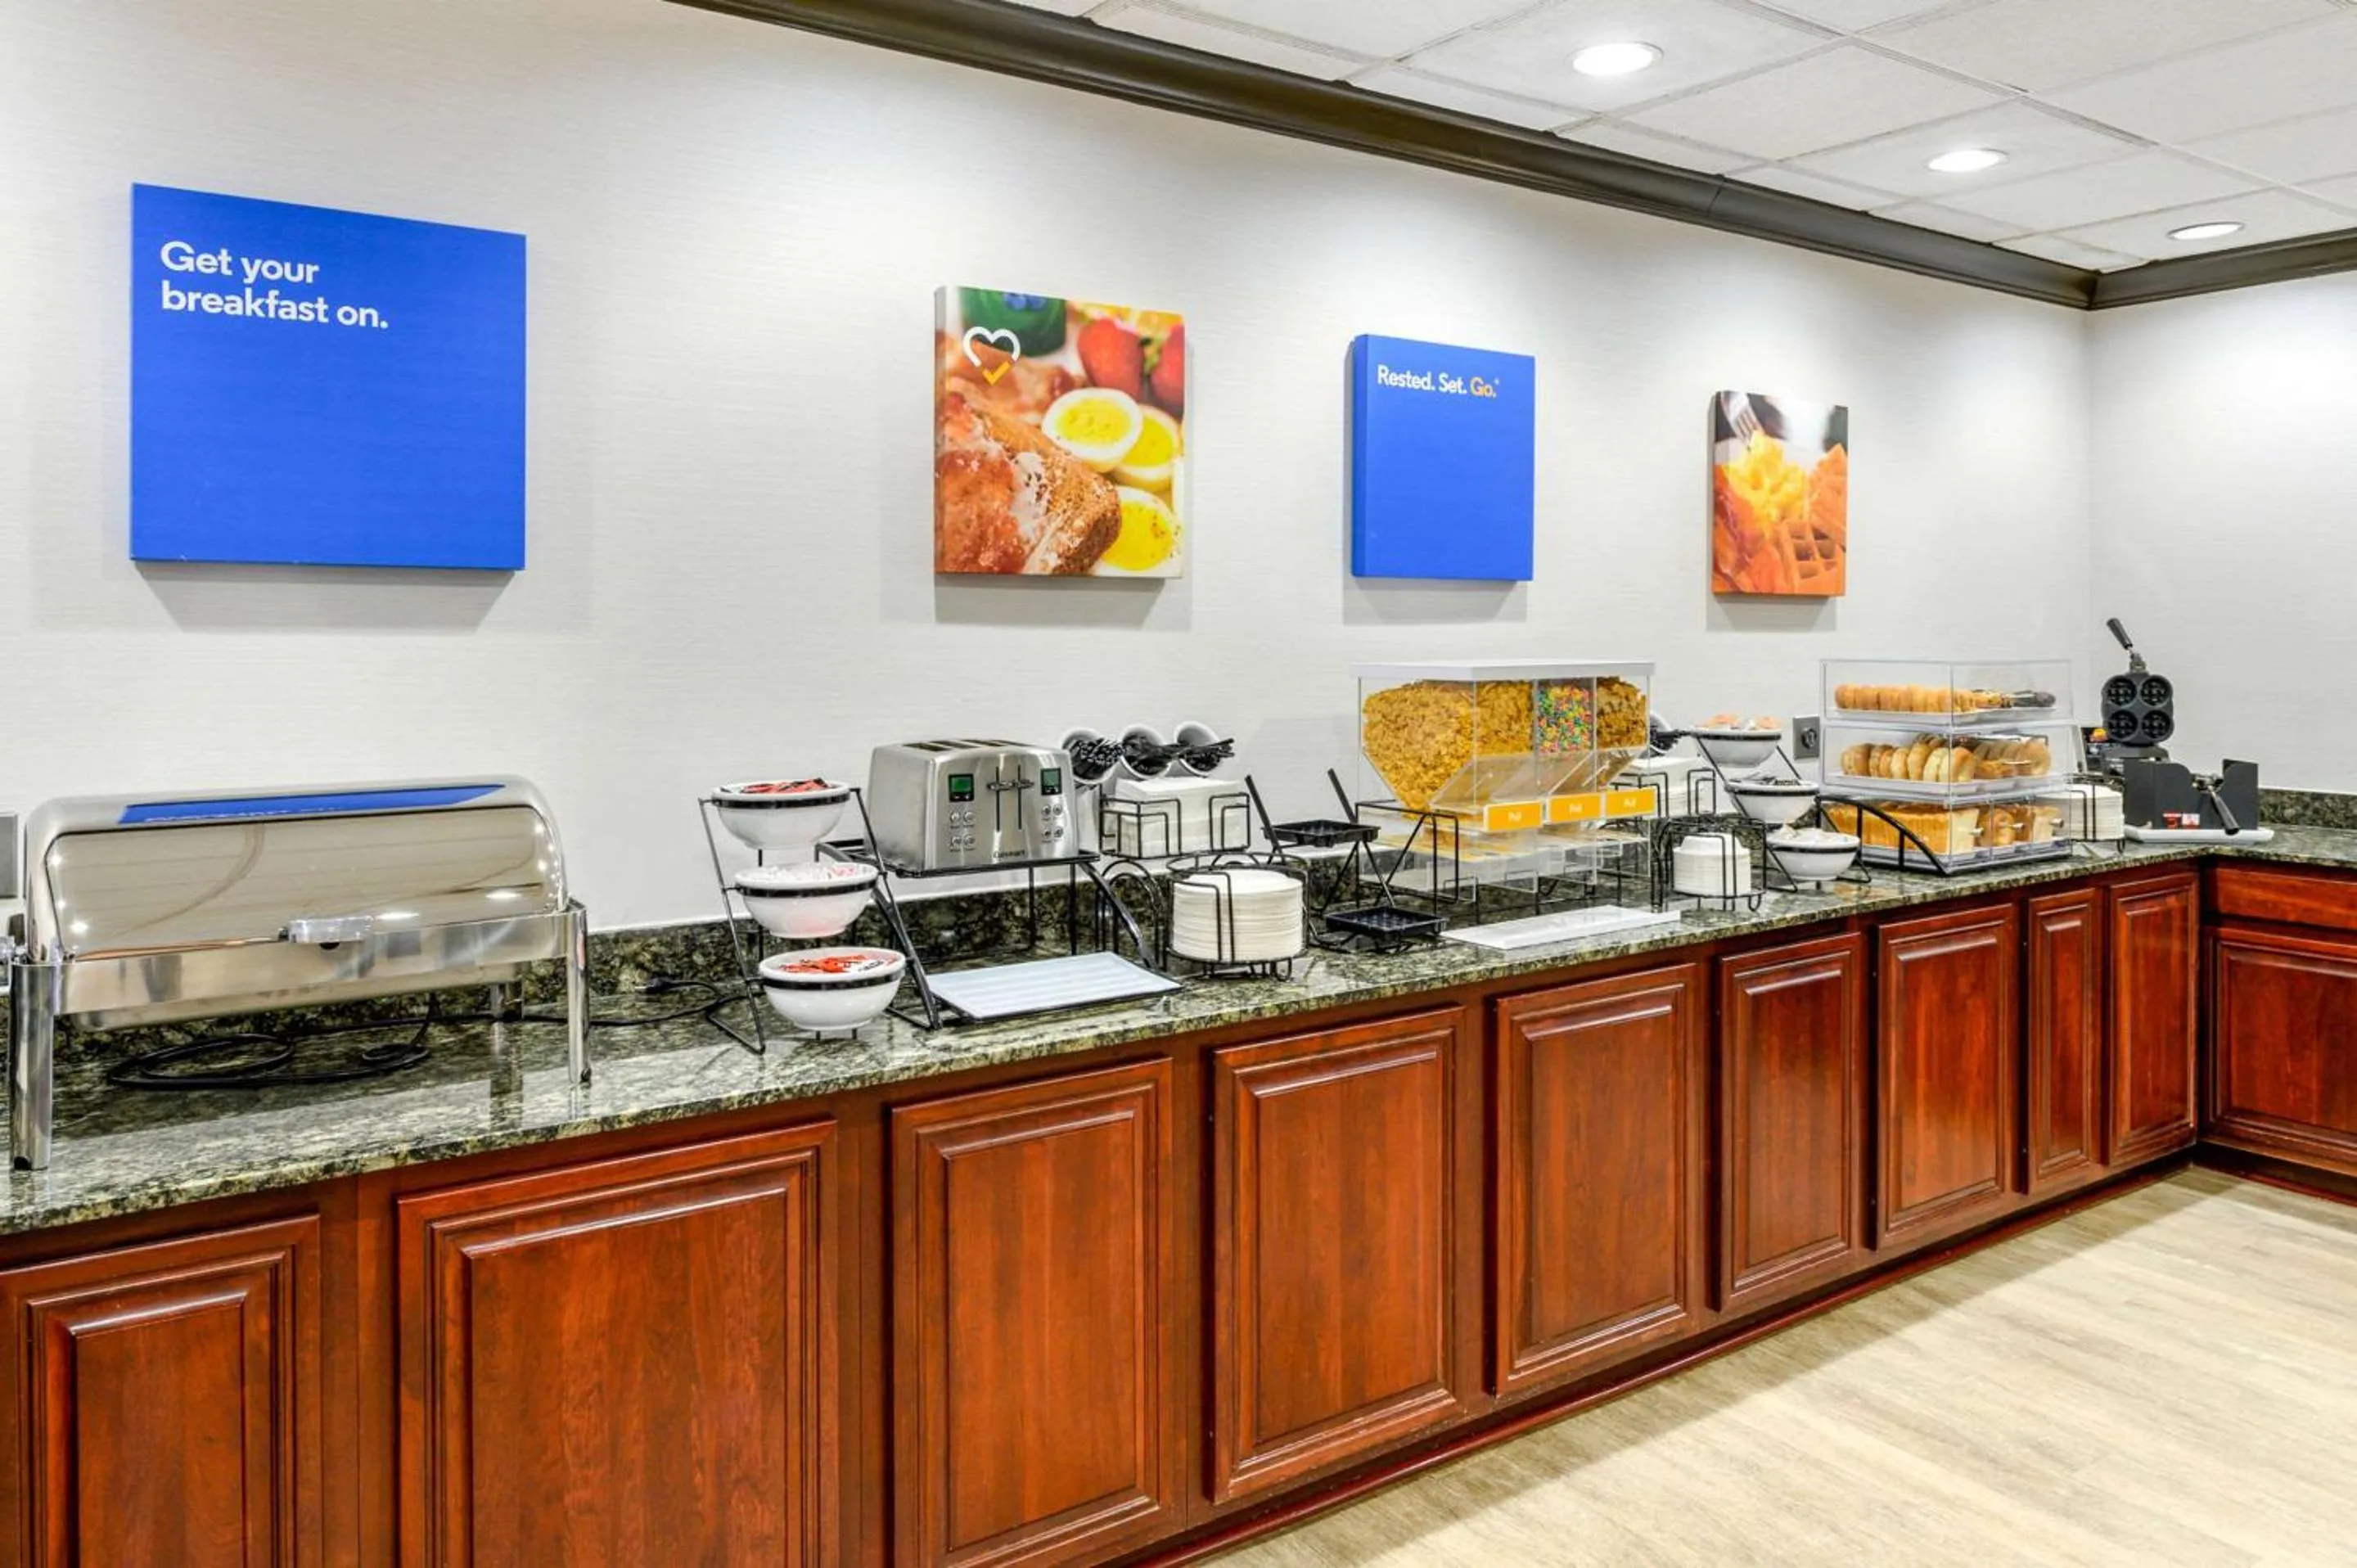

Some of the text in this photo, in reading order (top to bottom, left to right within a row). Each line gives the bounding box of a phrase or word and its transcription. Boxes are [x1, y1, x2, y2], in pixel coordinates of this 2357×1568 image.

[160, 241, 319, 284] Get your
[161, 279, 389, 329] breakfast on.
[1377, 364, 1436, 391] Rested.
[1438, 372, 1467, 394] Set.
